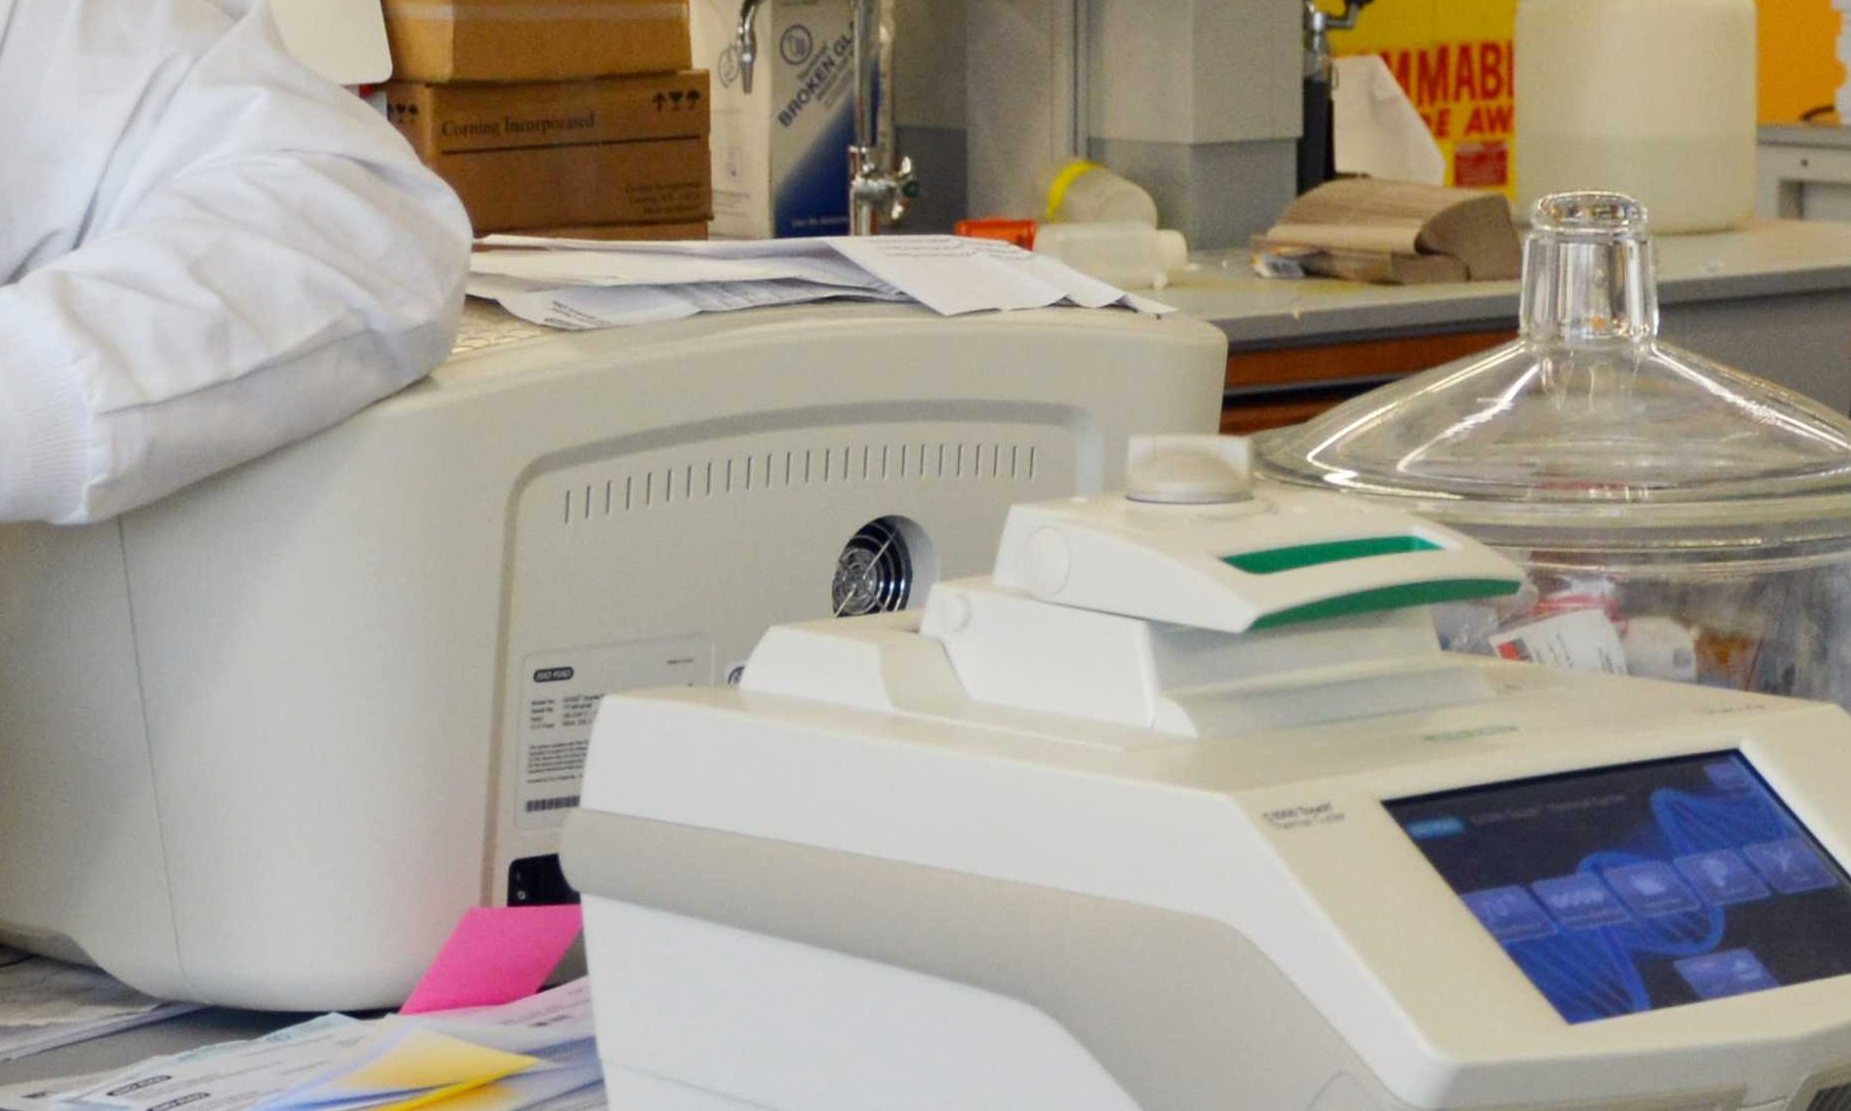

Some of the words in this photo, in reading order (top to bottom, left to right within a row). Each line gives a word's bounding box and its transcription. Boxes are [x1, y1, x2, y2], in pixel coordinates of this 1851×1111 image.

[778, 55, 835, 128] BROKEN
[441, 121, 500, 138] Corning
[504, 111, 596, 135] Incorporated
